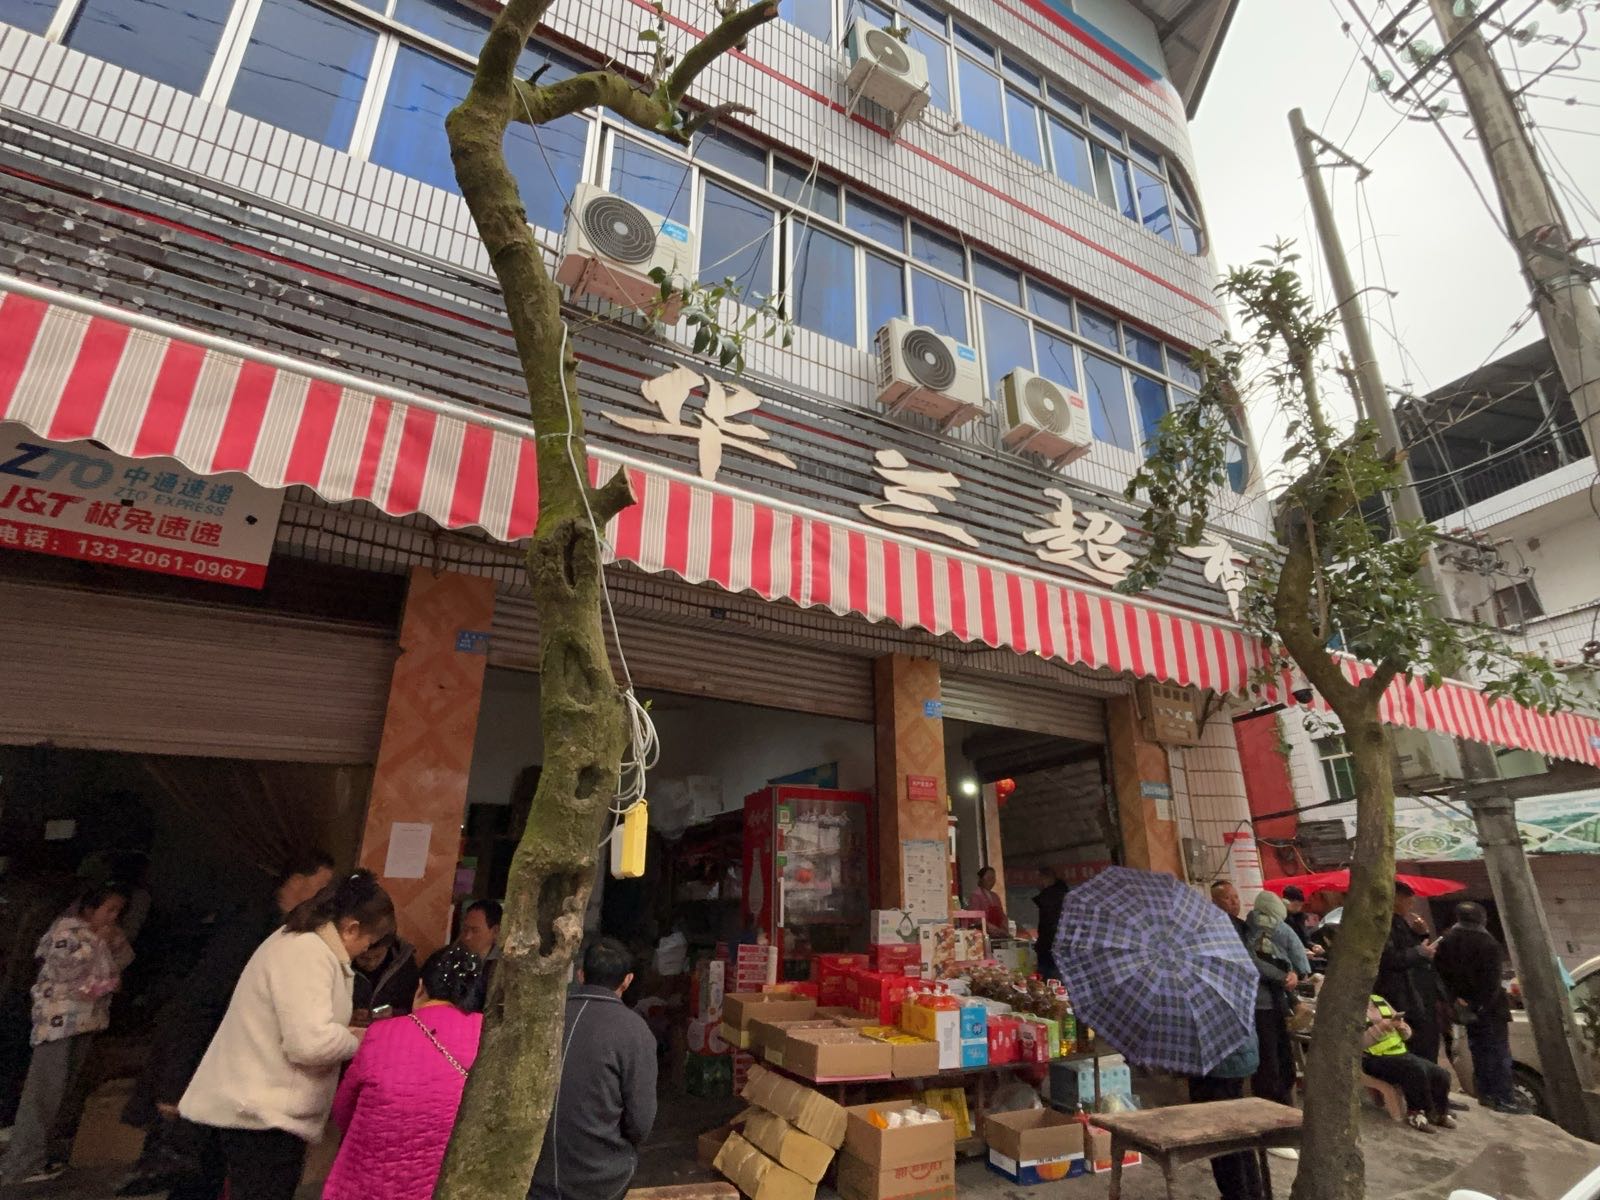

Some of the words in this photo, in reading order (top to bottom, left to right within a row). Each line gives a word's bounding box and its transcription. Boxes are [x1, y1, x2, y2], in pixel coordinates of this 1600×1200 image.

[0, 443, 114, 489] ZTO
[123, 466, 234, 505] 中通速递
[114, 486, 148, 504] ZTO
[155, 494, 225, 517] EXPRESS
[84, 500, 223, 547] 极兔速递
[78, 539, 247, 580] 133-2061-0967
